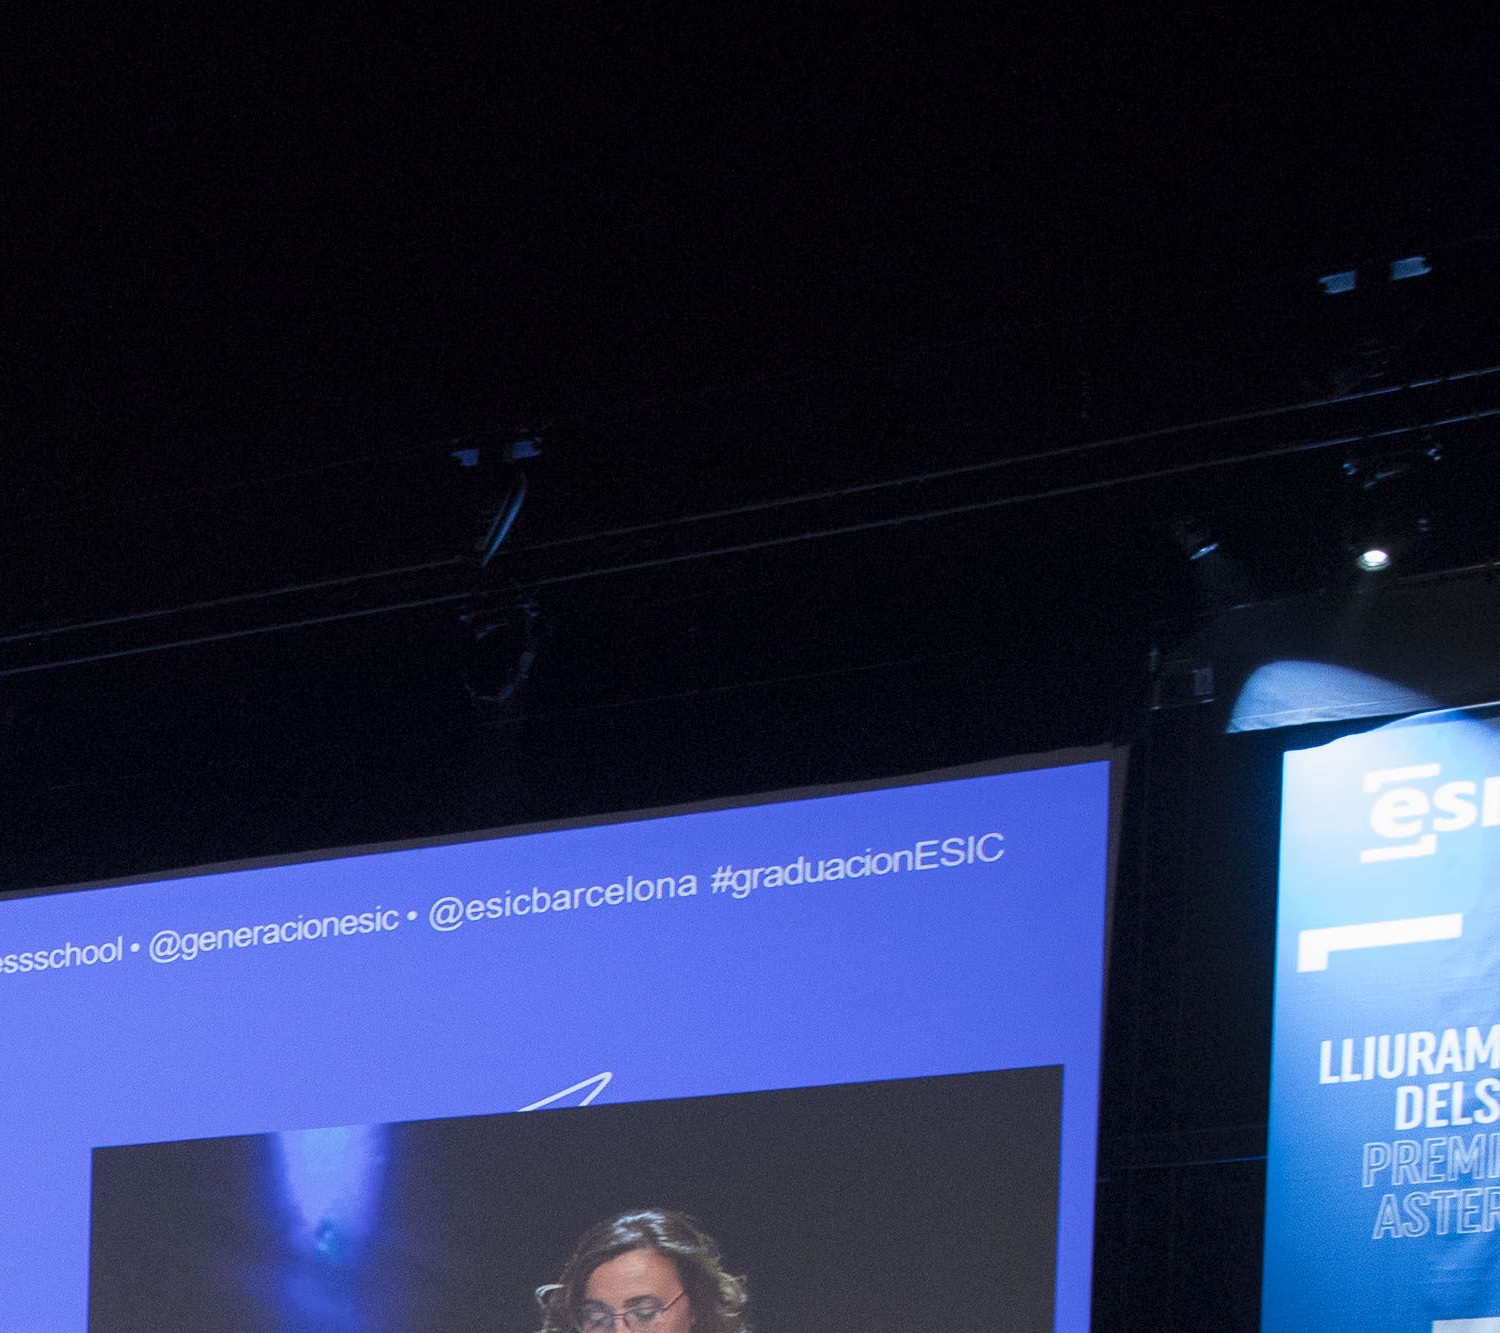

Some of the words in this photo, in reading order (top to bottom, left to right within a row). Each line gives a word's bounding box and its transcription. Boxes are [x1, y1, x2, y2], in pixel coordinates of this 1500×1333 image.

[148, 903, 400, 968] @generacionesic
[428, 872, 699, 933] @esicbarcelona
[710, 832, 1006, 899] #graduacionESIC
[1395, 1077, 1500, 1131] DELS
